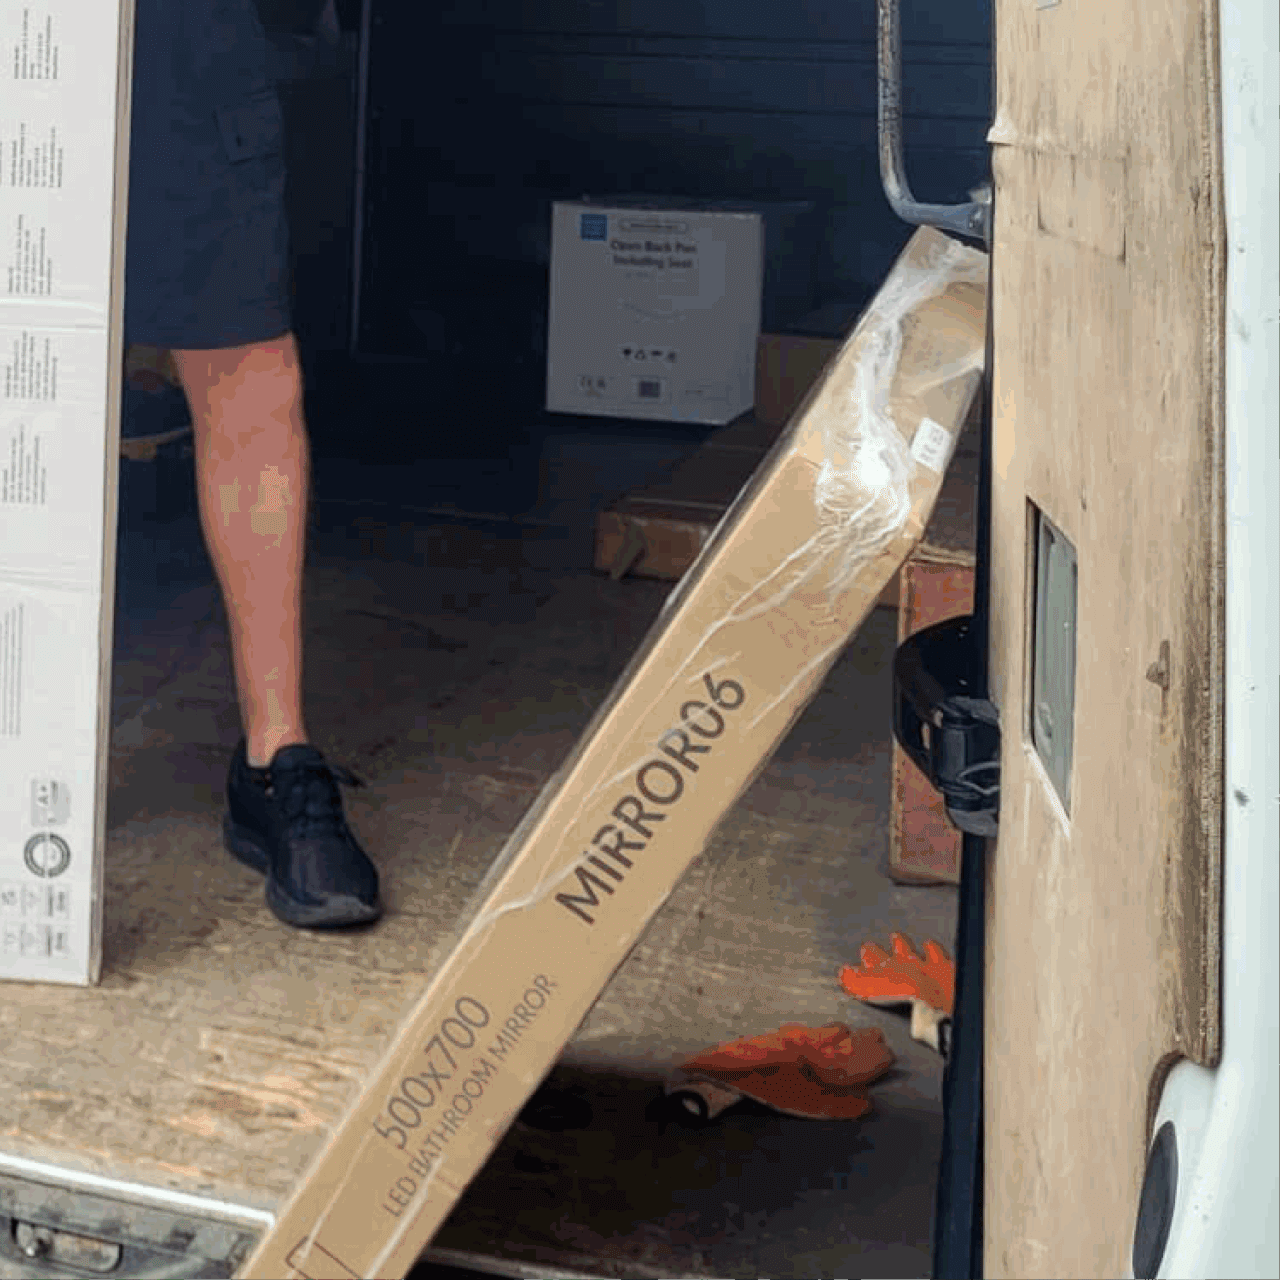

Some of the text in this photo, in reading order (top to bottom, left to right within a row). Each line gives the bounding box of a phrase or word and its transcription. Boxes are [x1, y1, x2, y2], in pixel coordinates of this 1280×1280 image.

[555, 673, 745, 925] MIRROR06
[373, 996, 490, 1150] 500x700
[383, 974, 558, 1217] LED BATHROOM MIRROR
